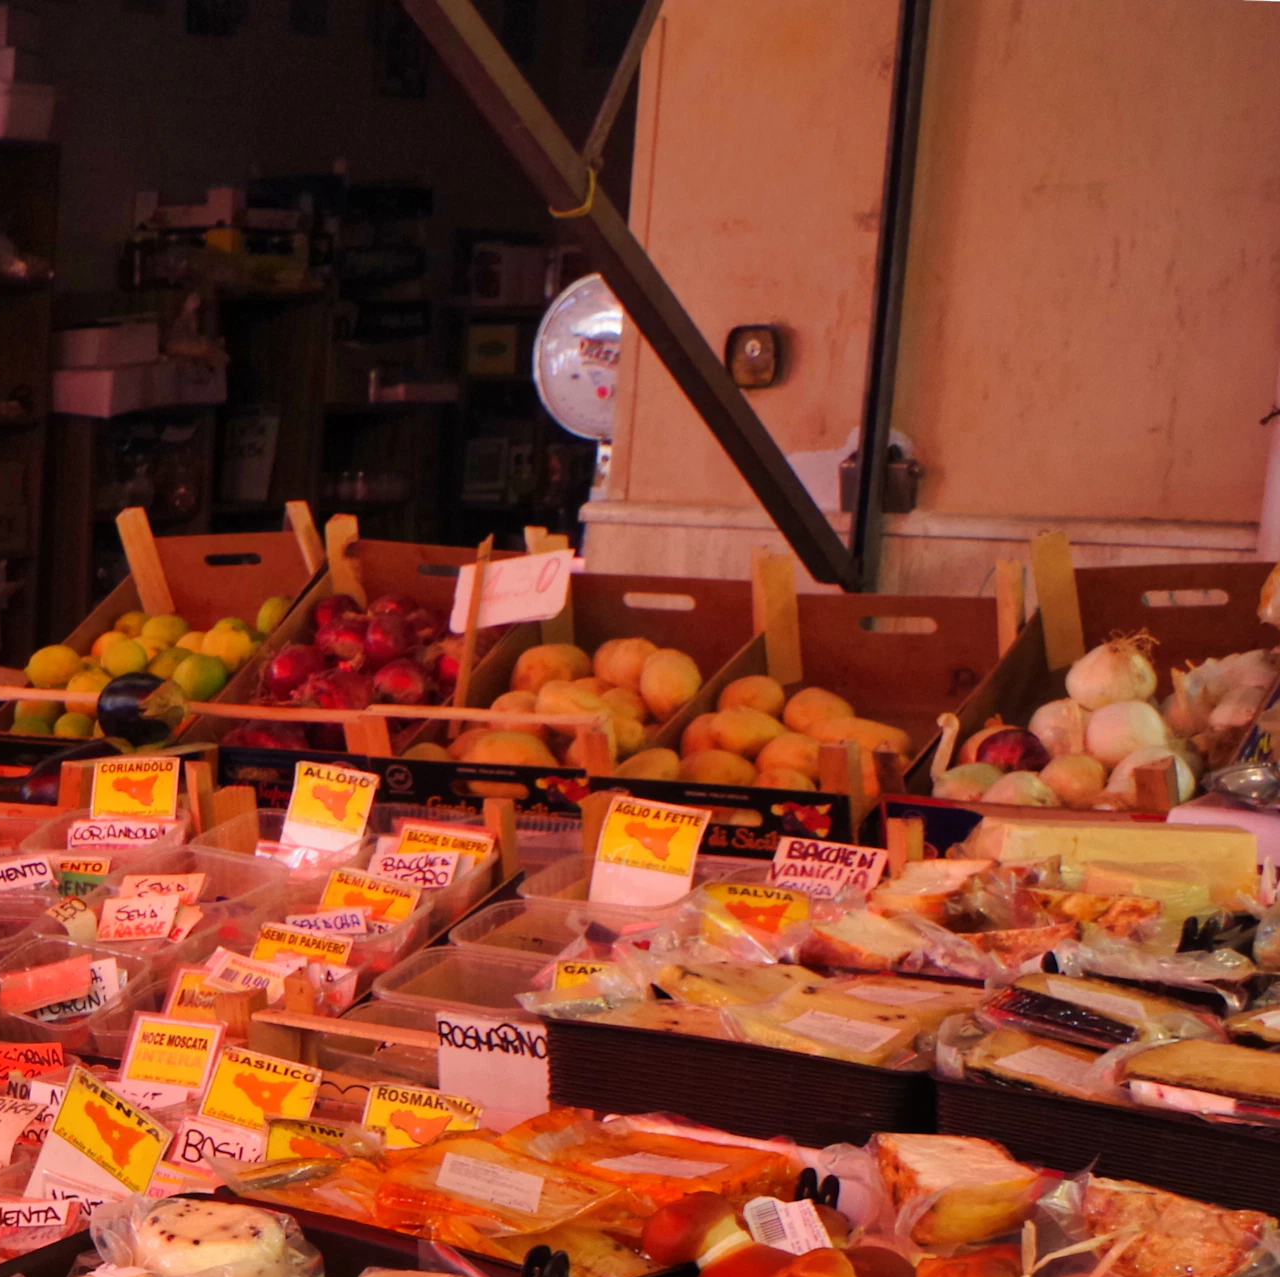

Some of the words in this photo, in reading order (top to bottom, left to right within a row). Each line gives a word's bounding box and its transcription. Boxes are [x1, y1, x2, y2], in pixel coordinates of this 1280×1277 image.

[100, 760, 174, 775] CORIANDOLO
[303, 765, 369, 788] ALLORO
[614, 802, 649, 822] AGLIO
[666, 810, 704, 829] FETTE
[407, 829, 438, 845] BACCHE
[440, 835, 449, 846] DI
[451, 836, 488, 854] GINEPRO
[787, 840, 856, 866] BACCHE
[336, 872, 365, 888] SEMI
[367, 877, 381, 892] DI
[383, 879, 413, 901] CHIA
[728, 886, 794, 902] SALVIA
[265, 928, 288, 944] SEMI
[300, 935, 346, 955] PAPAVERO
[140, 1031, 165, 1045] NOCE
[166, 1034, 208, 1051] MOSCATA
[227, 1053, 316, 1084] BASILICO
[79, 1074, 160, 1142] MENTA
